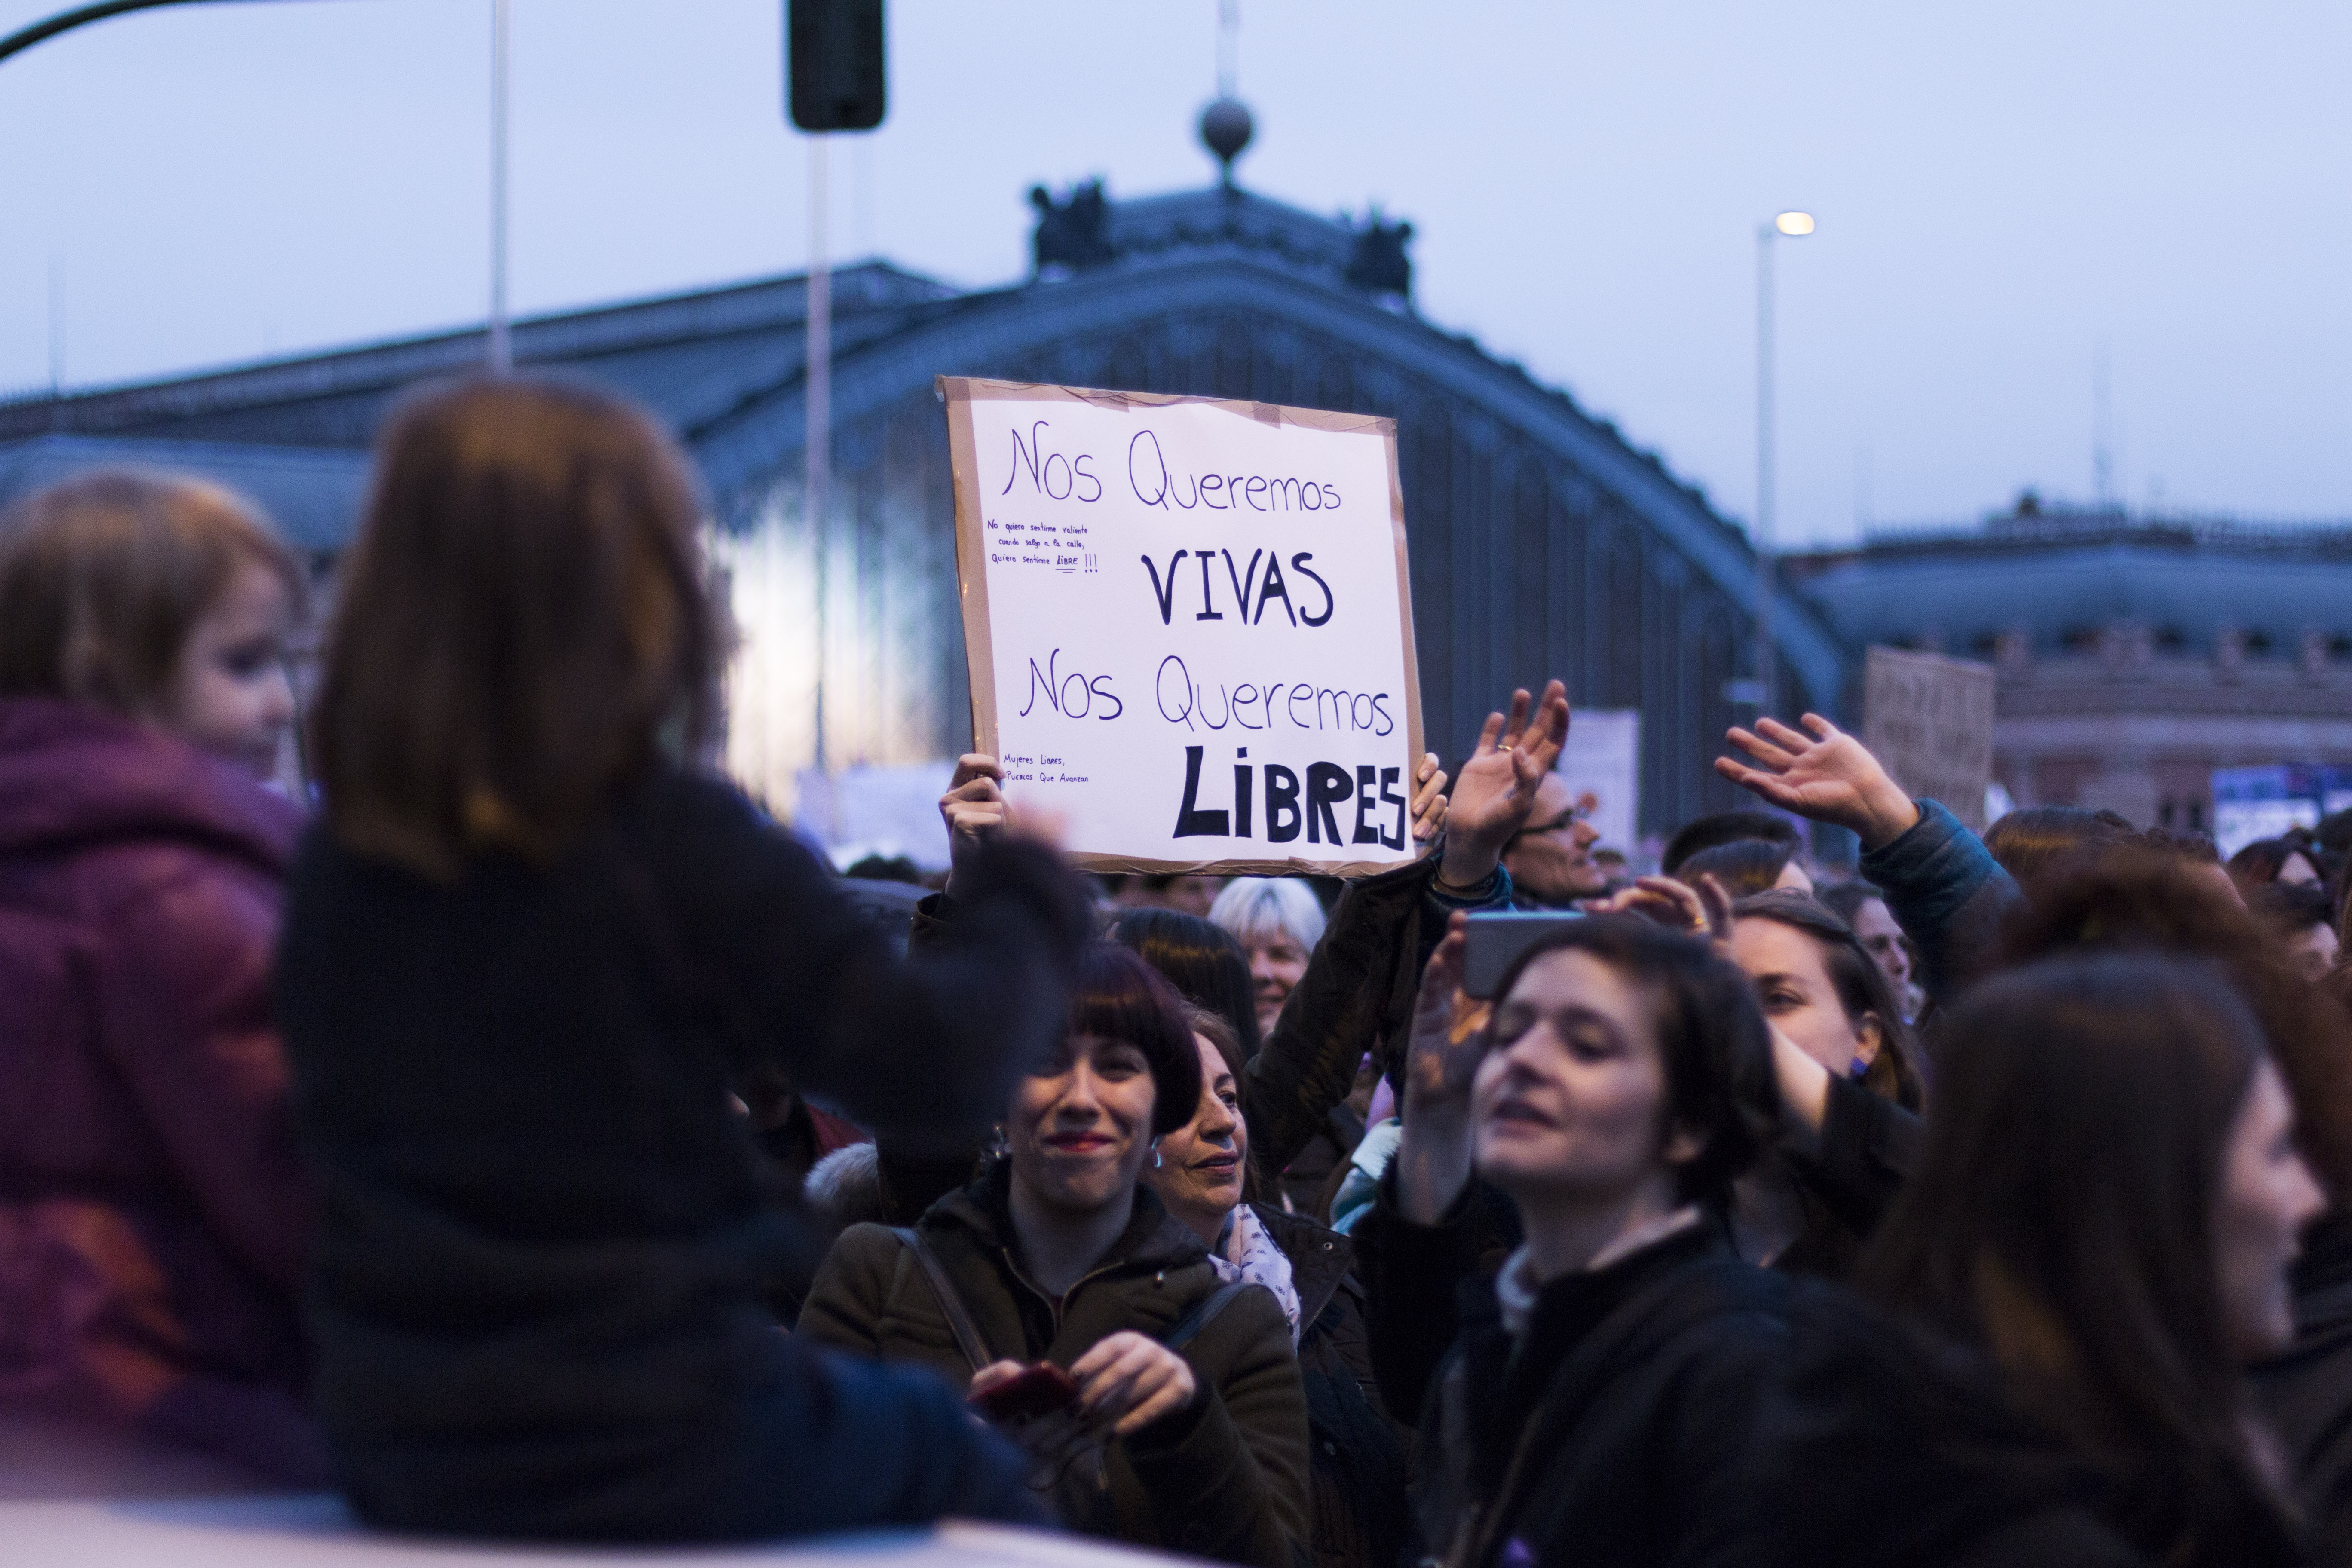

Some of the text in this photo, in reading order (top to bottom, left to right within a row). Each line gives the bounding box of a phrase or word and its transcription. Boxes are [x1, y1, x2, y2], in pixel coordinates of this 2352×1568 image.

[1129, 430, 1341, 511] Queremos
[987, 519, 1088, 534] No quiero sentirme valiente
[998, 537, 1019, 545] cuando
[1025, 538, 1041, 549] salgo
[1053, 539, 1061, 547] la
[1066, 539, 1084, 550] calle,
[992, 553, 1017, 564] Quiero
[1141, 548, 1333, 628] VIVAS
[1157, 655, 1393, 736] Queremos
[1004, 753, 1033, 768] Mujeres
[1039, 772, 1054, 783] Que
[1059, 772, 1088, 783] Avanzan
